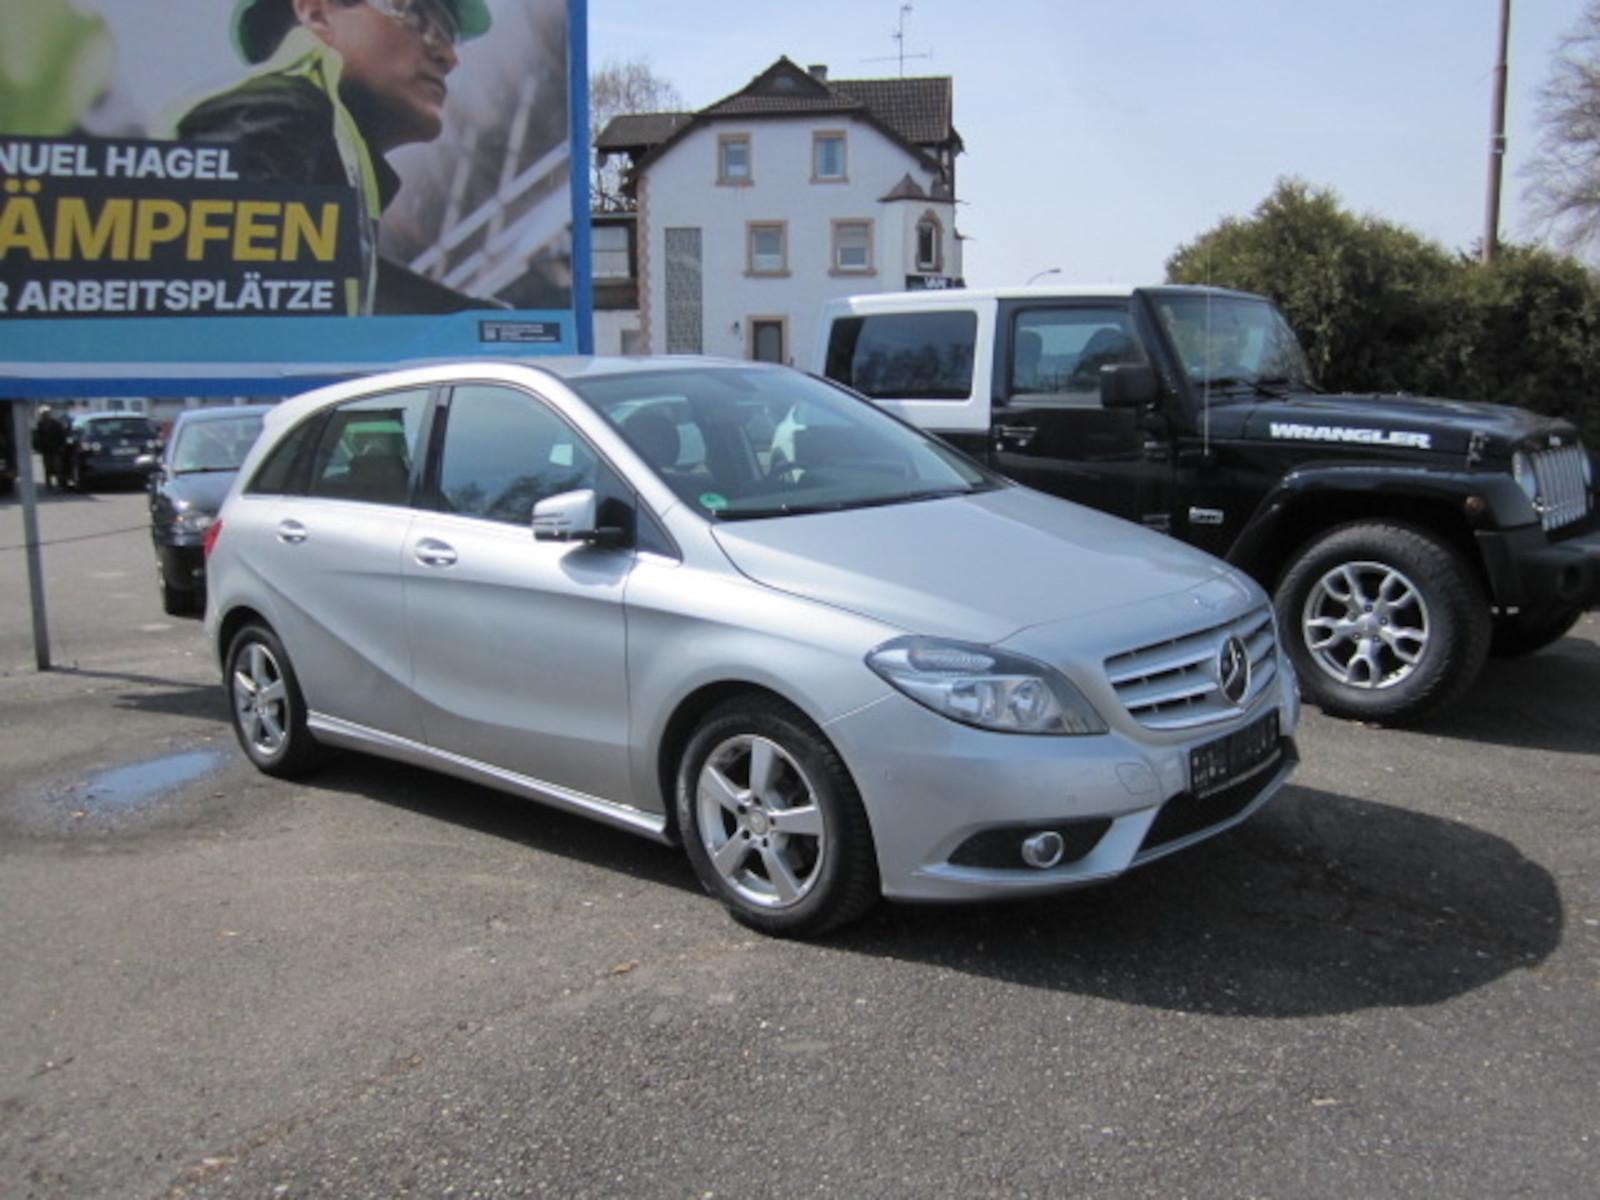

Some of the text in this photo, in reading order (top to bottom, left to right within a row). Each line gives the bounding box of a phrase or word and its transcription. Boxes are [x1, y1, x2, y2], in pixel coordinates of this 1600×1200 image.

[106, 146, 239, 180] HAGEL
[0, 178, 339, 261] ÄMPFEN
[16, 272, 334, 312] ARBEITSPLÄTZE
[1269, 421, 1432, 449] WRANGLER
